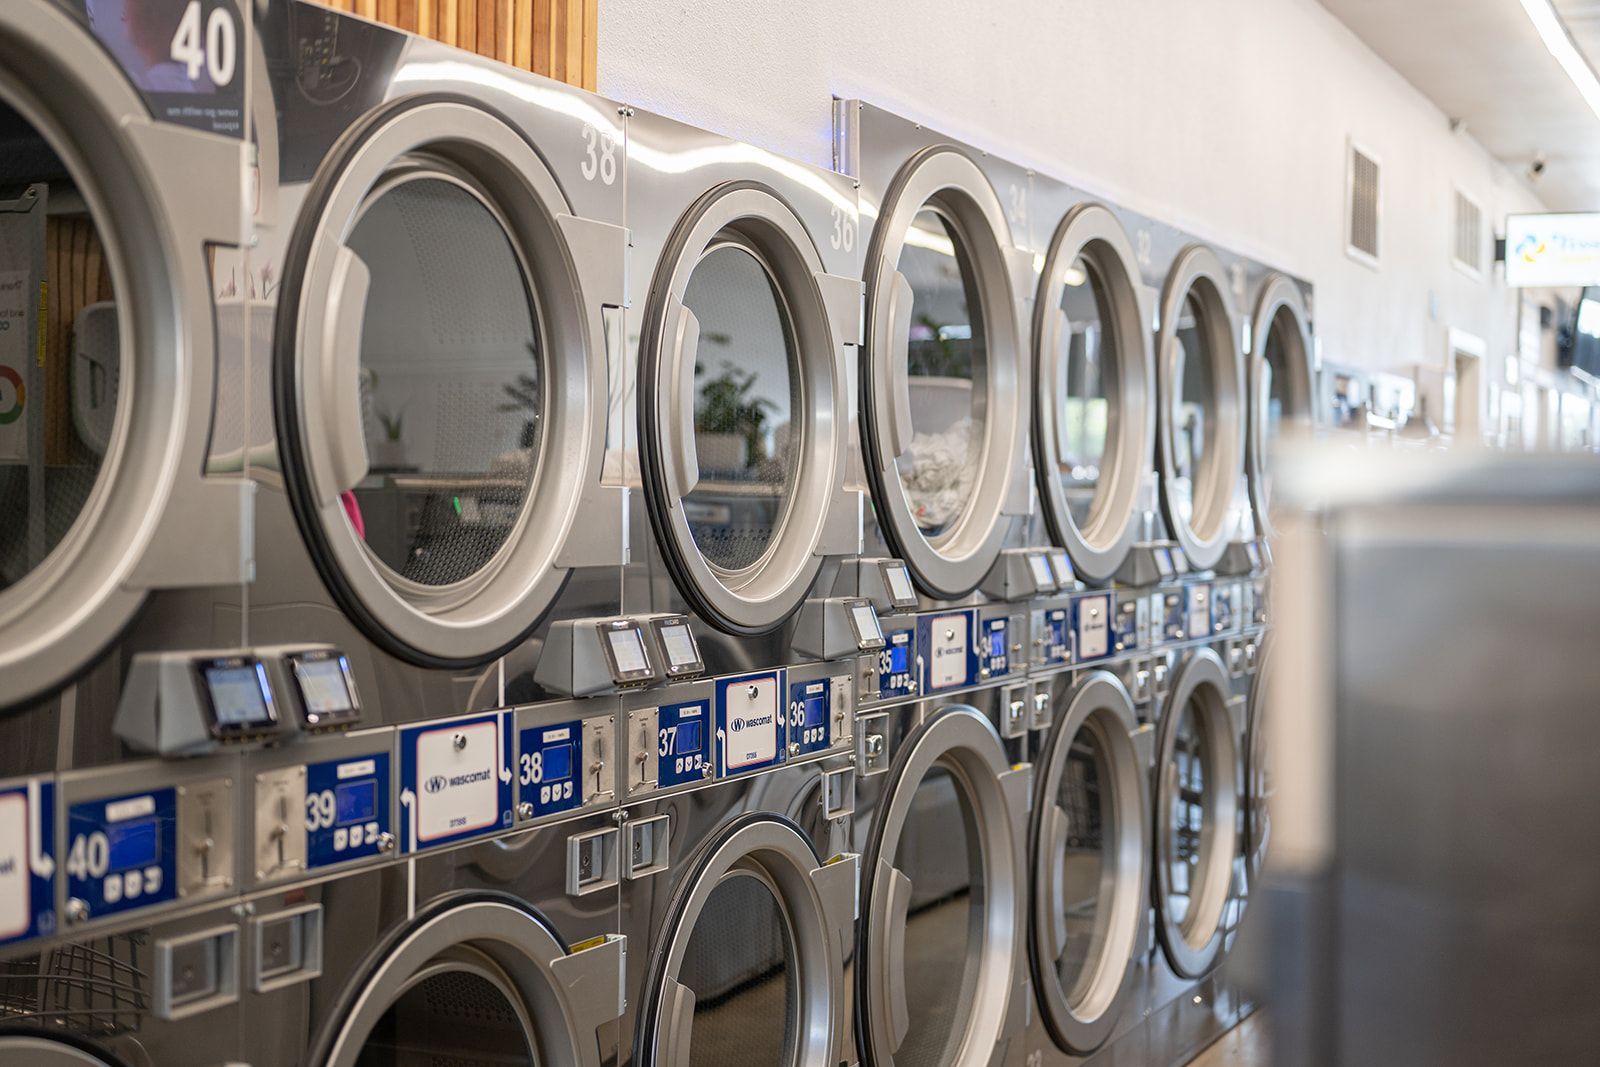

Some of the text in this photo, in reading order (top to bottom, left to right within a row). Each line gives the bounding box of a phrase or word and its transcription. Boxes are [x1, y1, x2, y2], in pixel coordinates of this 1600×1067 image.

[170, 1, 237, 87] 40
[580, 124, 616, 187] 38
[829, 203, 854, 253] 36
[879, 650, 892, 674] 35
[746, 714, 773, 728] wascomat
[790, 701, 805, 727] 36
[659, 727, 677, 758] 37
[449, 768, 491, 788] wascomat
[519, 751, 543, 786] 38
[305, 789, 336, 832] 39
[67, 831, 110, 882] 40
